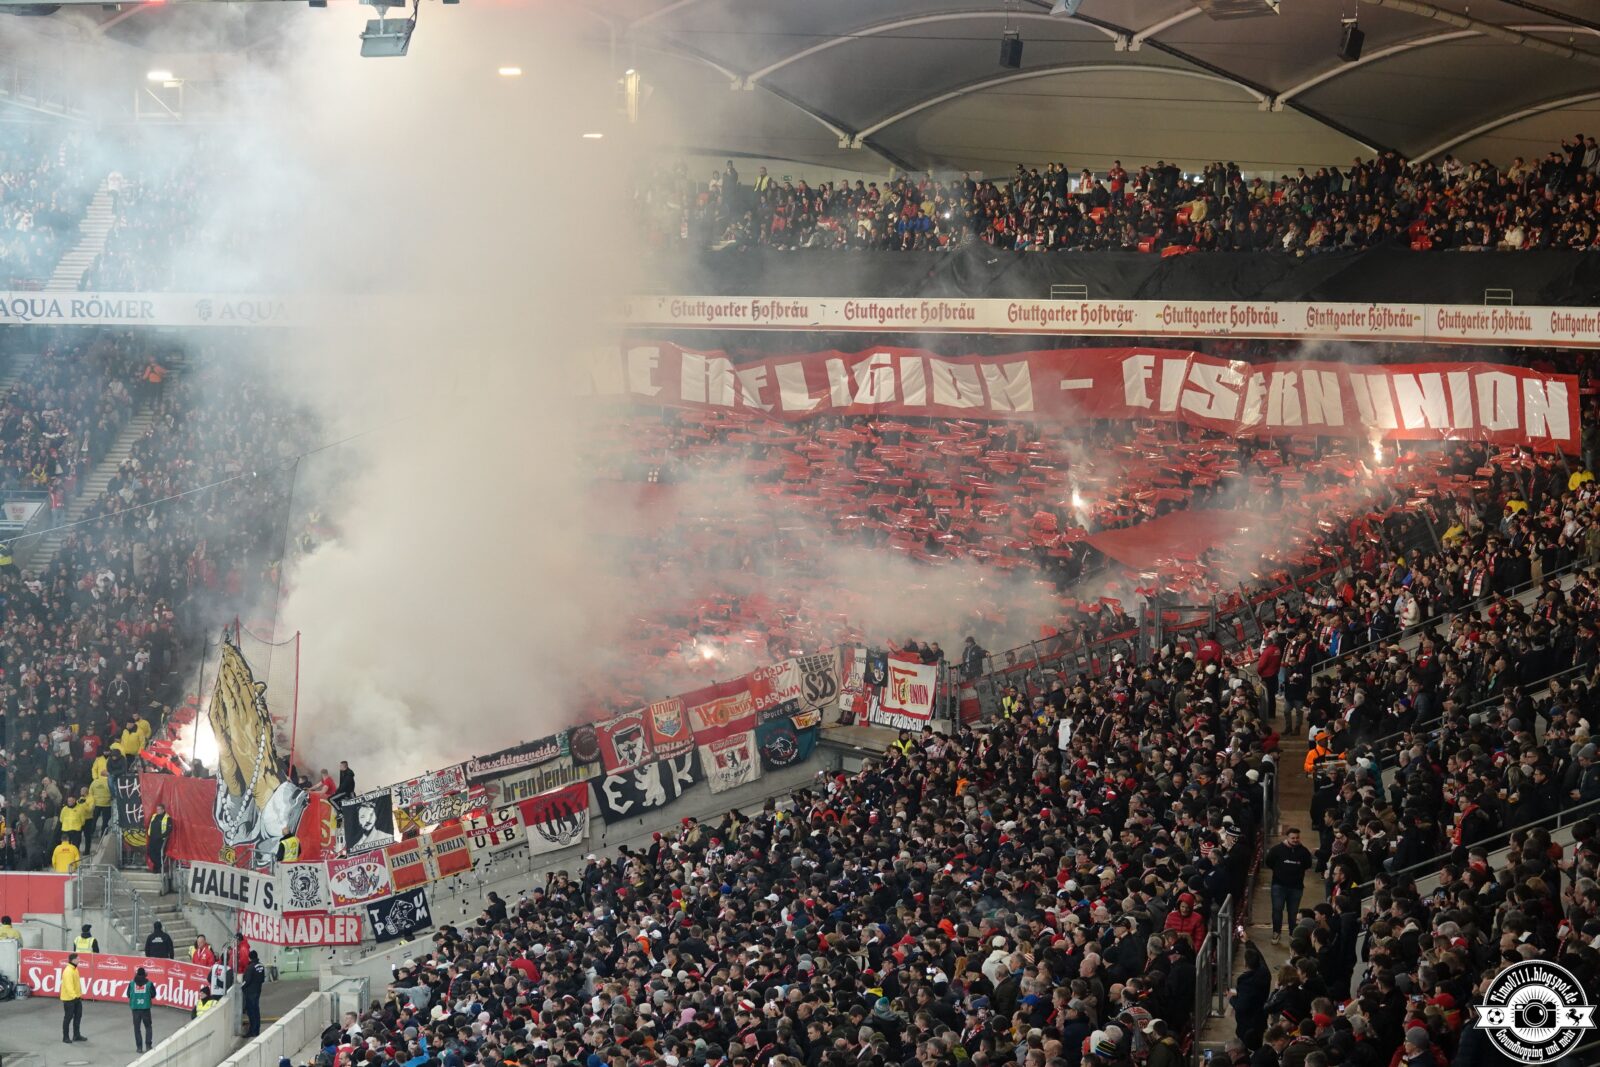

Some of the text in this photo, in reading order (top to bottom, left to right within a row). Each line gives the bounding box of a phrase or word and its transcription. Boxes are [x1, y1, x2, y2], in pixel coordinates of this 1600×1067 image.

[71, 296, 155, 319] RÖMER
[670, 299, 809, 322] Stuttgarter Hofbräu
[844, 301, 975, 324] Stuttgarter Hofbräu
[1007, 303, 1134, 326] Stuttgarter Hofbräu
[1162, 305, 1278, 328] Stuttgarter Hofbräu
[1306, 306, 1413, 331] Stuttgarter Hofbräu
[1437, 308, 1533, 335] Stuttgarter Hofbräu
[680, 350, 1034, 413] RELIGION
[1121, 352, 1345, 427] EISERN
[1349, 371, 1571, 440] UNION
[756, 684, 800, 709] BARNIM
[452, 793, 490, 815] Spree
[498, 809, 509, 822] C
[475, 828, 516, 850] U B
[391, 851, 421, 868] EISERN
[436, 839, 466, 854] BERLIN
[336, 873, 348, 883] 20
[366, 864, 378, 874] 07
[191, 867, 250, 903] HALLE
[263, 882, 279, 910] S.
[239, 914, 359, 944] SACHSENADLER
